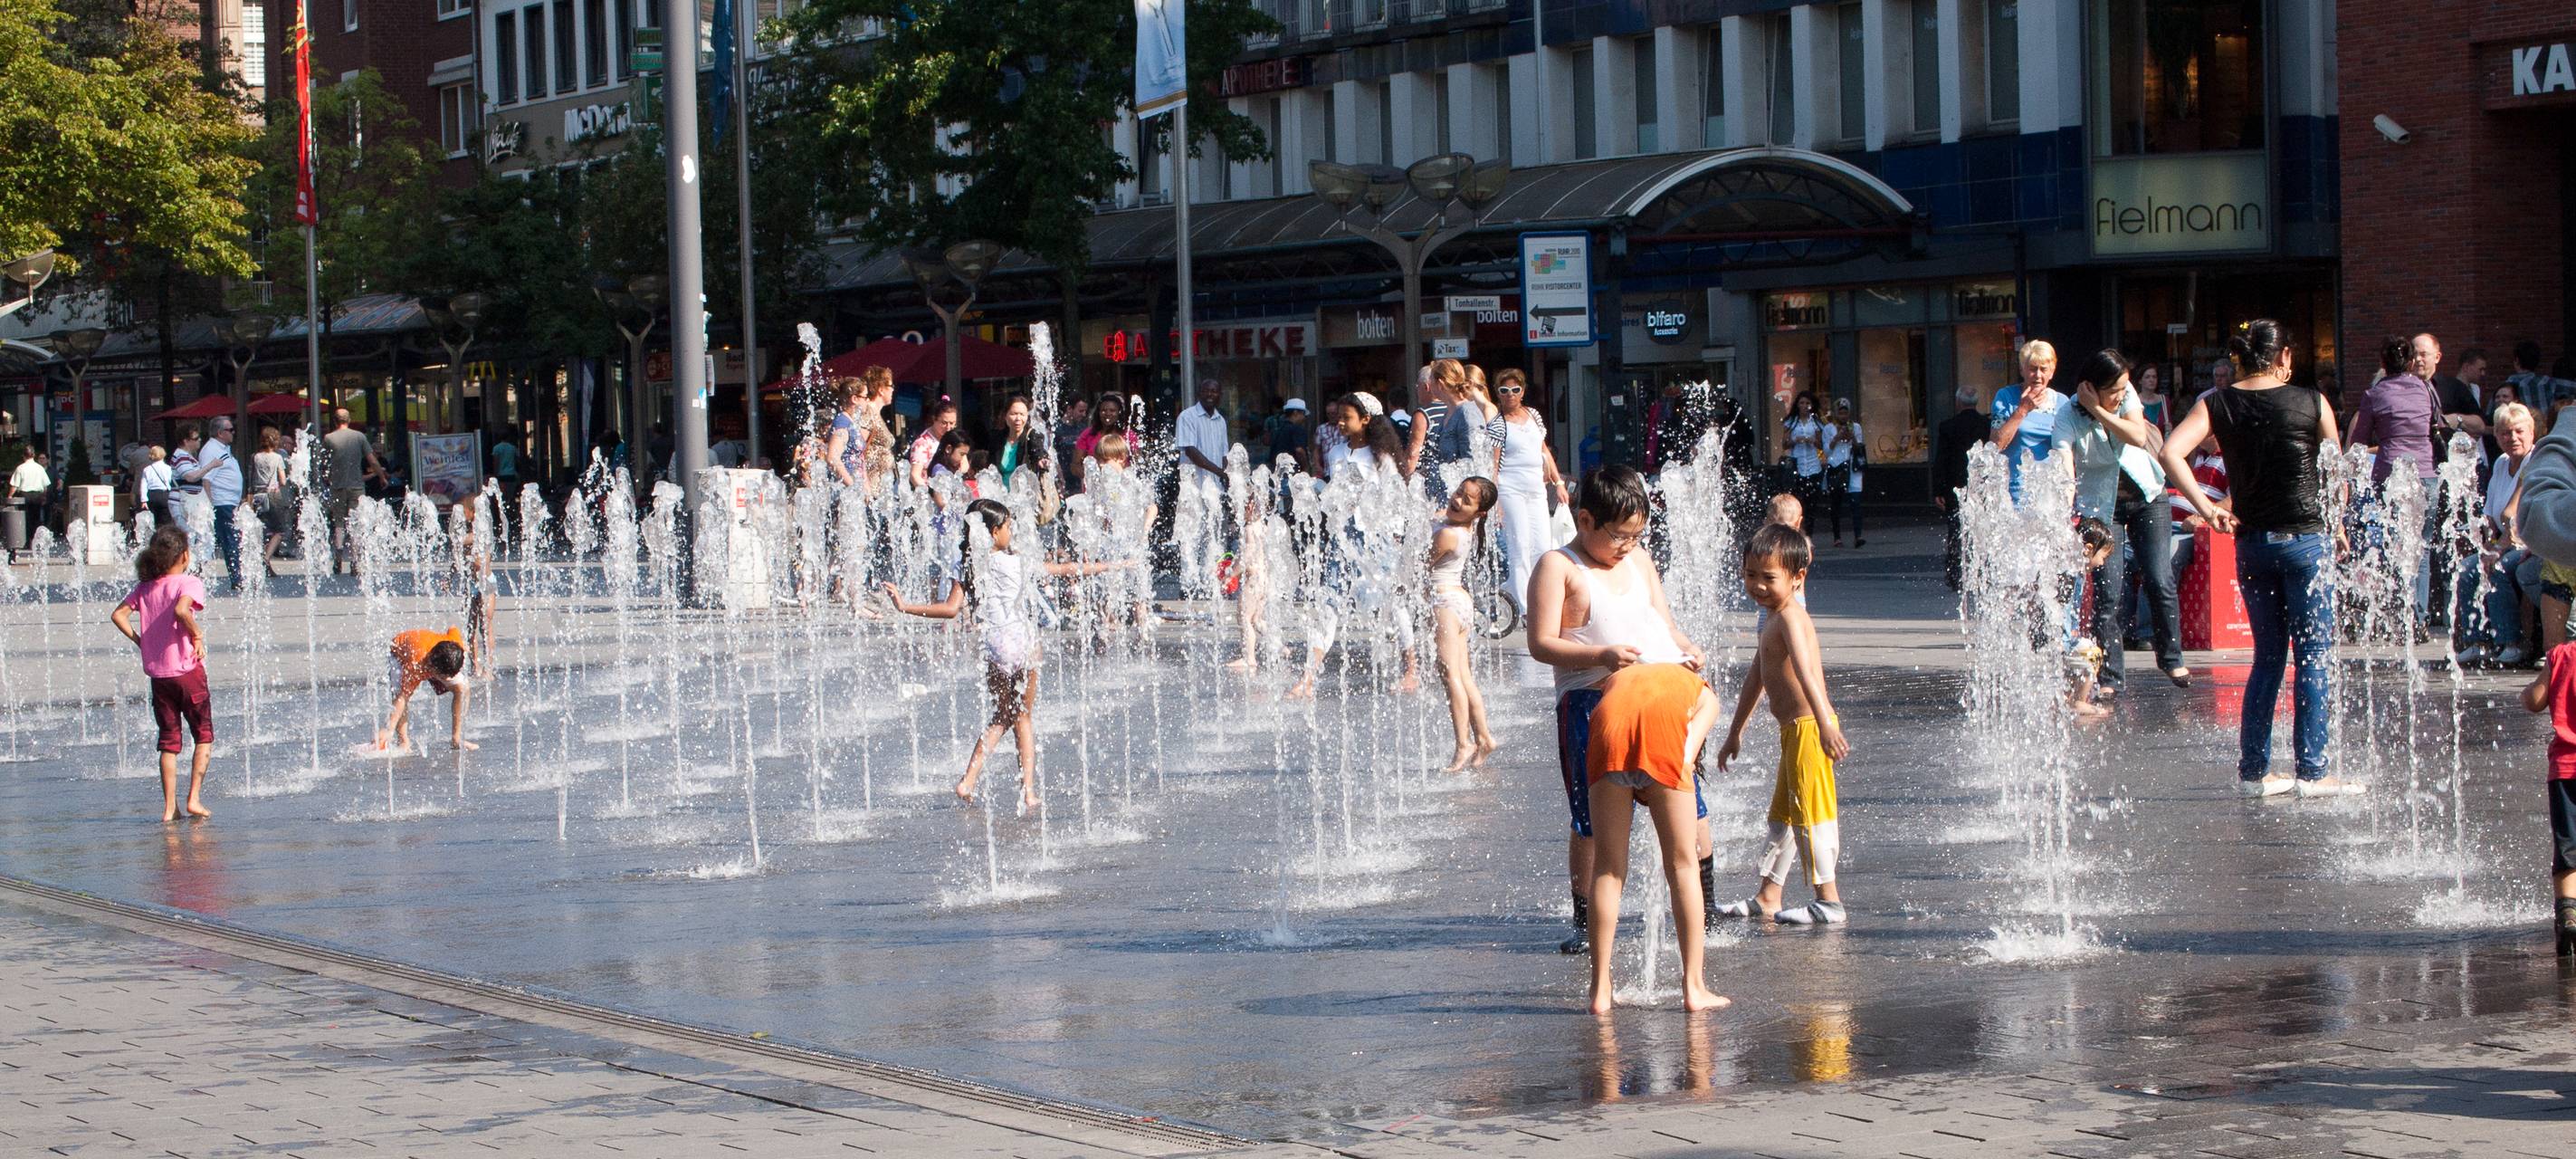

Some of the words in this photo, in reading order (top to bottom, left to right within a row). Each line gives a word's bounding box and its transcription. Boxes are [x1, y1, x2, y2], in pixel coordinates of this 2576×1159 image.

[1221, 59, 1292, 96] APOTHEKE
[566, 101, 632, 143] McDona
[2096, 196, 2262, 235] fielmann
[1476, 310, 1518, 323] bolten
[1959, 288, 2015, 315] fielman
[1357, 310, 1396, 340] bolten
[1133, 326, 1306, 359] AOTHEKE
